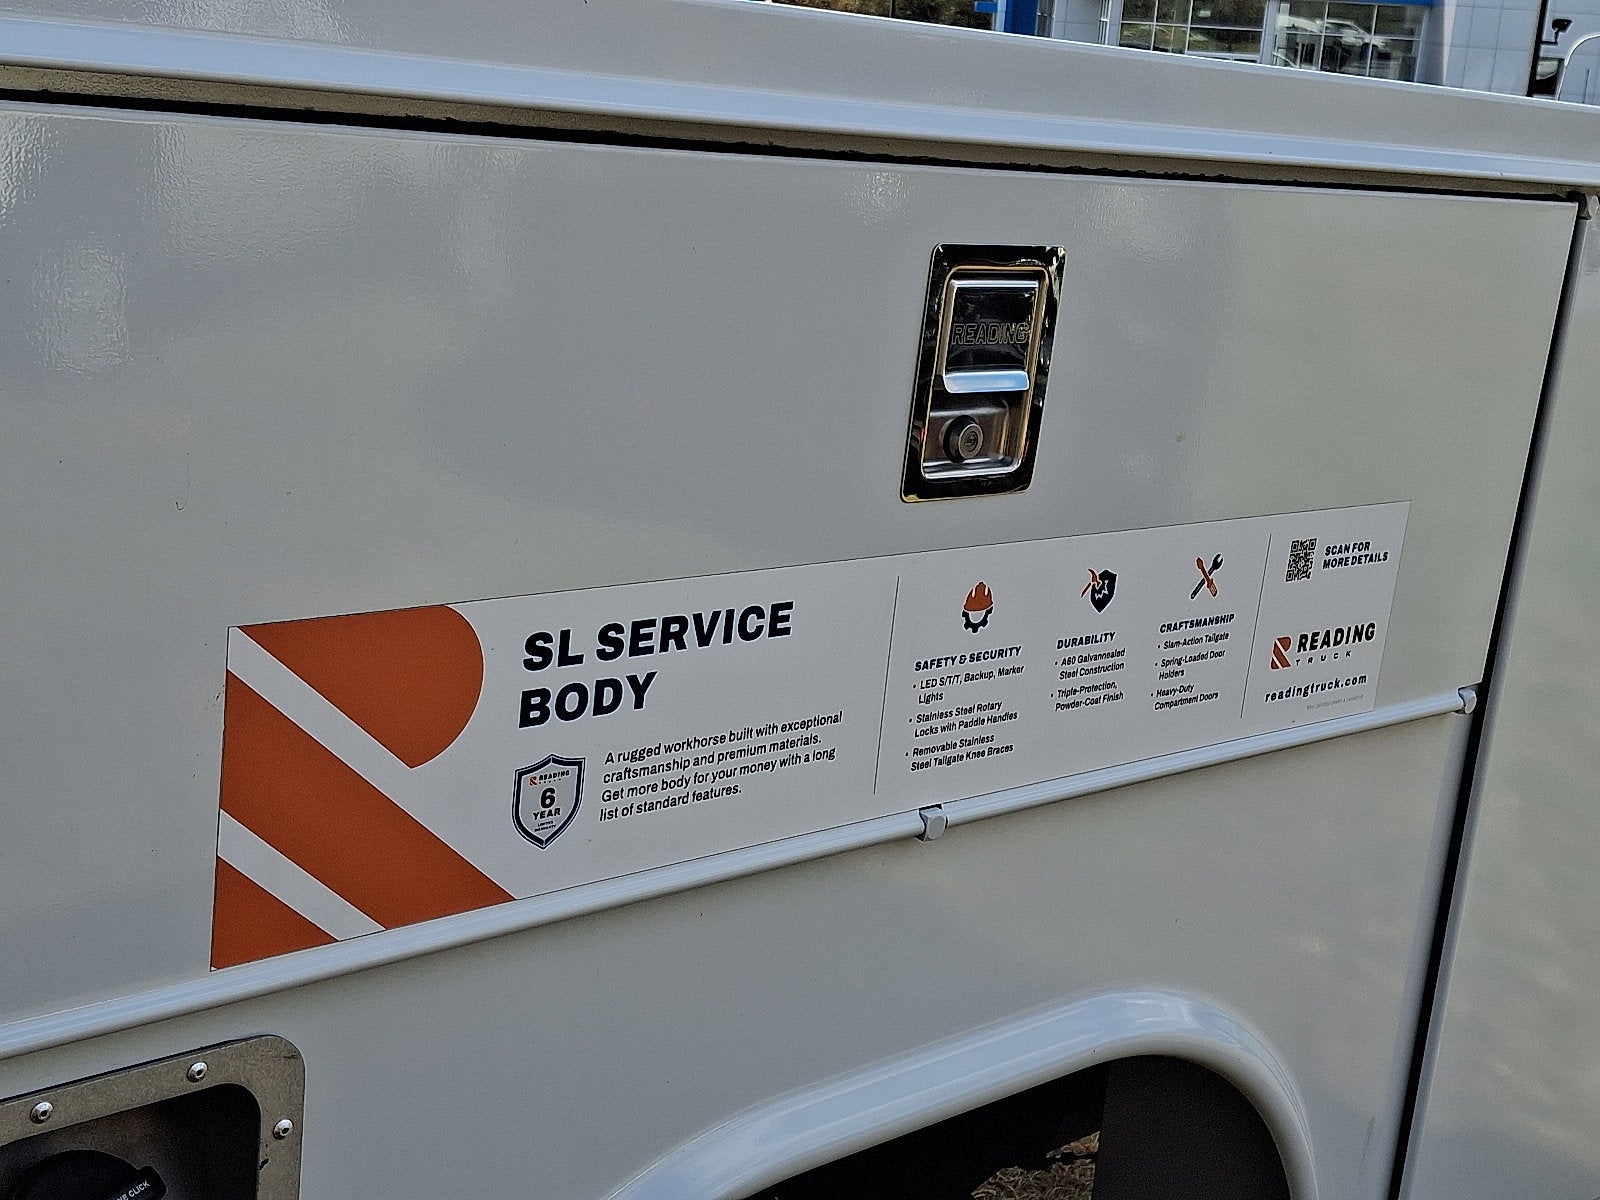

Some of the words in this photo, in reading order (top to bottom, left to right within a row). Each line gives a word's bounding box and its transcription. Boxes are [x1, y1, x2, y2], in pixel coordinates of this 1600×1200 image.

[952, 323, 1030, 344] READING
[1325, 544, 1350, 556] SCAN
[1352, 541, 1370, 552] FOR
[1323, 557, 1350, 569] MORE
[1351, 552, 1388, 566] DETAILS
[1159, 614, 1235, 633] CRAFTSMANSHIP
[522, 629, 584, 672] SL
[596, 601, 794, 662] SERVICE
[1057, 632, 1116, 649] DURABILITY
[1204, 632, 1230, 645] Tailgate
[1297, 622, 1376, 653] READING
[915, 656, 957, 671] SAFETY
[959, 655, 967, 664] &
[969, 646, 1022, 663] SECURITY
[1161, 652, 1209, 668] Spring-Loaded
[1210, 650, 1225, 659] Door
[1296, 650, 1351, 666] TRUCK
[920, 679, 937, 690] LED
[964, 670, 995, 683] Backup,
[998, 665, 1024, 676] Marker
[1059, 670, 1078, 680] Steel
[1079, 662, 1125, 676] Construction
[1159, 669, 1185, 680] Holders
[918, 692, 944, 704] Lights
[1102, 691, 1124, 704] Finish
[1156, 684, 1194, 698] Heavy-Duty
[1265, 674, 1367, 702] readingtruck.com
[518, 671, 658, 728] BODY
[1154, 694, 1198, 711] Compartment
[1200, 691, 1218, 701] Doors
[916, 709, 953, 723] Stainless
[955, 705, 975, 716] Steel
[977, 702, 1002, 713] Rotary
[915, 724, 938, 738] Locks
[940, 722, 956, 732] with
[958, 718, 985, 730] Paddle
[987, 711, 1018, 724] Handles
[605, 752, 614, 765] A
[617, 743, 661, 764] rugged
[664, 734, 726, 754] workhorse
[728, 727, 753, 742] built
[755, 722, 778, 738] with
[781, 711, 842, 734] exceptional
[913, 741, 957, 757] Removable
[959, 735, 995, 748] Stainless
[603, 756, 690, 784] craftsmanship
[693, 753, 714, 768] and
[717, 745, 766, 765] premium
[768, 733, 821, 753] materials.
[911, 758, 931, 771] Steel
[934, 754, 964, 766] Tailgate
[966, 750, 985, 760] Knee
[987, 744, 1014, 756] Braces
[601, 788, 624, 802] Get
[627, 784, 658, 798] more
[661, 774, 691, 795] body
[693, 772, 709, 785] for
[711, 768, 737, 784] your
[739, 762, 777, 779] money
[779, 754, 801, 770] with
[804, 753, 810, 763] a
[812, 748, 835, 762] long
[540, 788, 556, 808] 6
[600, 806, 618, 822] list
[621, 802, 634, 816] of
[636, 793, 689, 814] standard
[691, 784, 742, 805] features.
[533, 808, 560, 820] YEAR
[128, 1180, 150, 1197] CLICK
